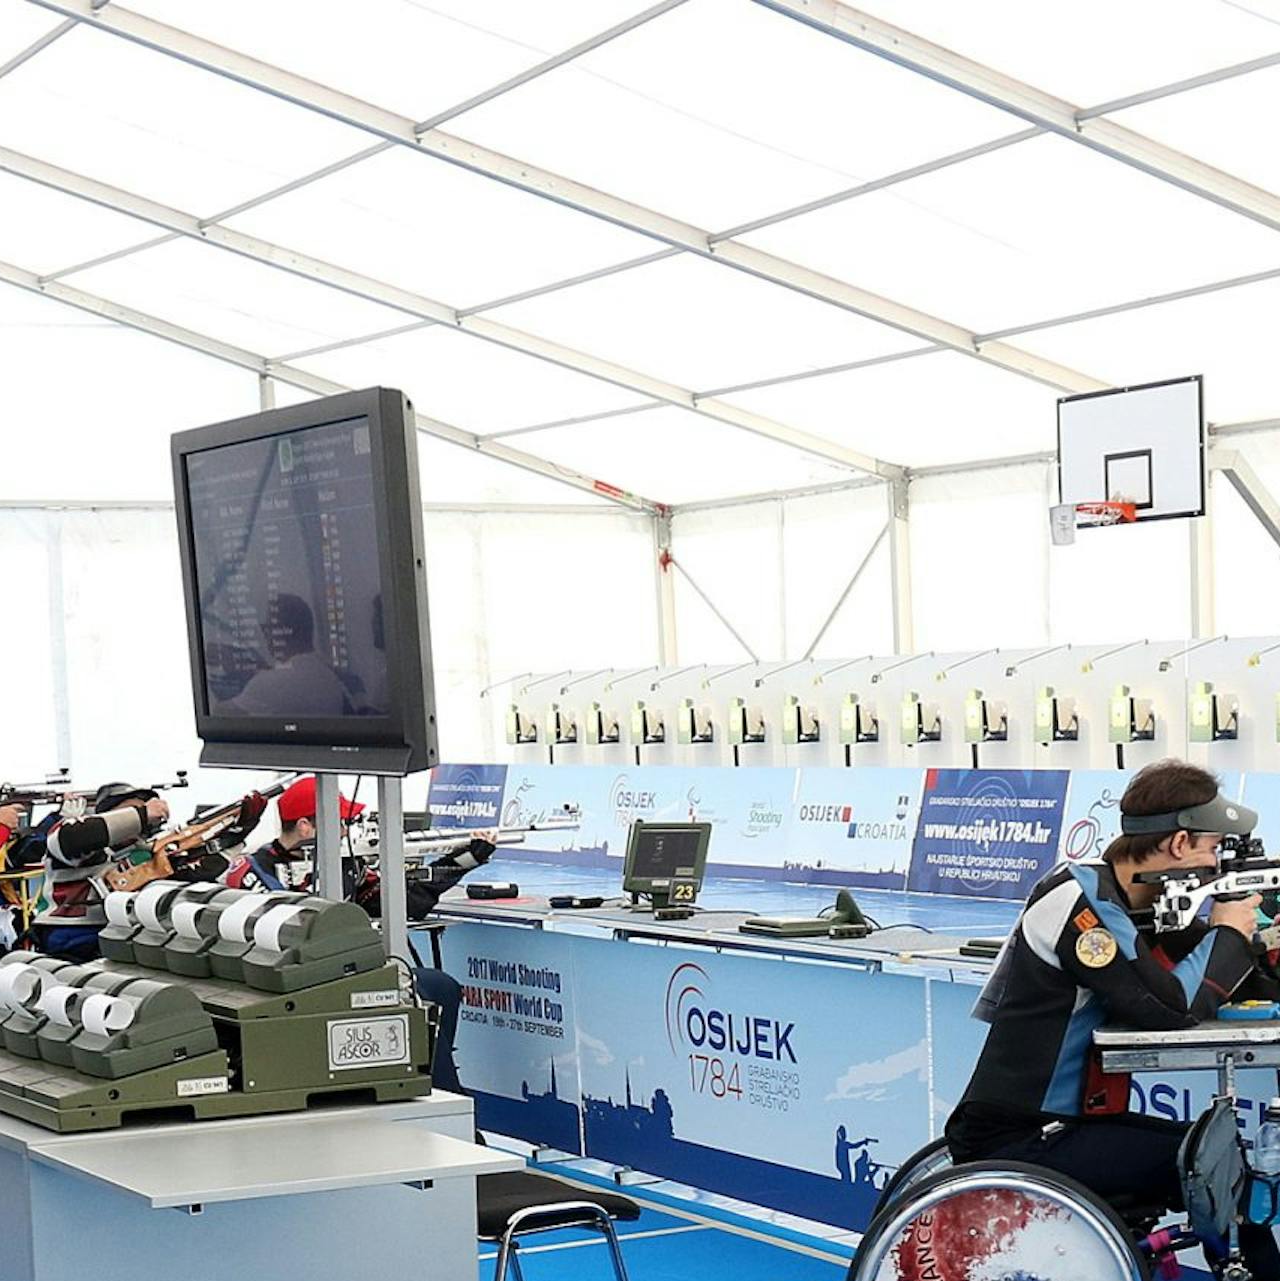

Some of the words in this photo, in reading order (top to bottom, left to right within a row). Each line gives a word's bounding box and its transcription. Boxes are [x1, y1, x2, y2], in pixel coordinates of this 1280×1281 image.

[616, 791, 656, 808] OSIJEK
[800, 805, 842, 822] OSIJEK
[857, 823, 908, 840] CROATIA
[924, 819, 1052, 845] www.osijek1784.hr
[674, 884, 694, 900] 23
[467, 957, 488, 980] 2017
[488, 960, 517, 985] World
[519, 964, 560, 993] Shooting
[461, 985, 483, 1008] PARA
[484, 988, 512, 1013] SPORT
[513, 992, 543, 1019] World
[544, 998, 562, 1024] Cup
[346, 1027, 372, 1043] SIUS
[524, 1021, 564, 1039] SEPTEMBER
[687, 1007, 798, 1064] OSIJEK
[688, 1053, 743, 1101] 1784
